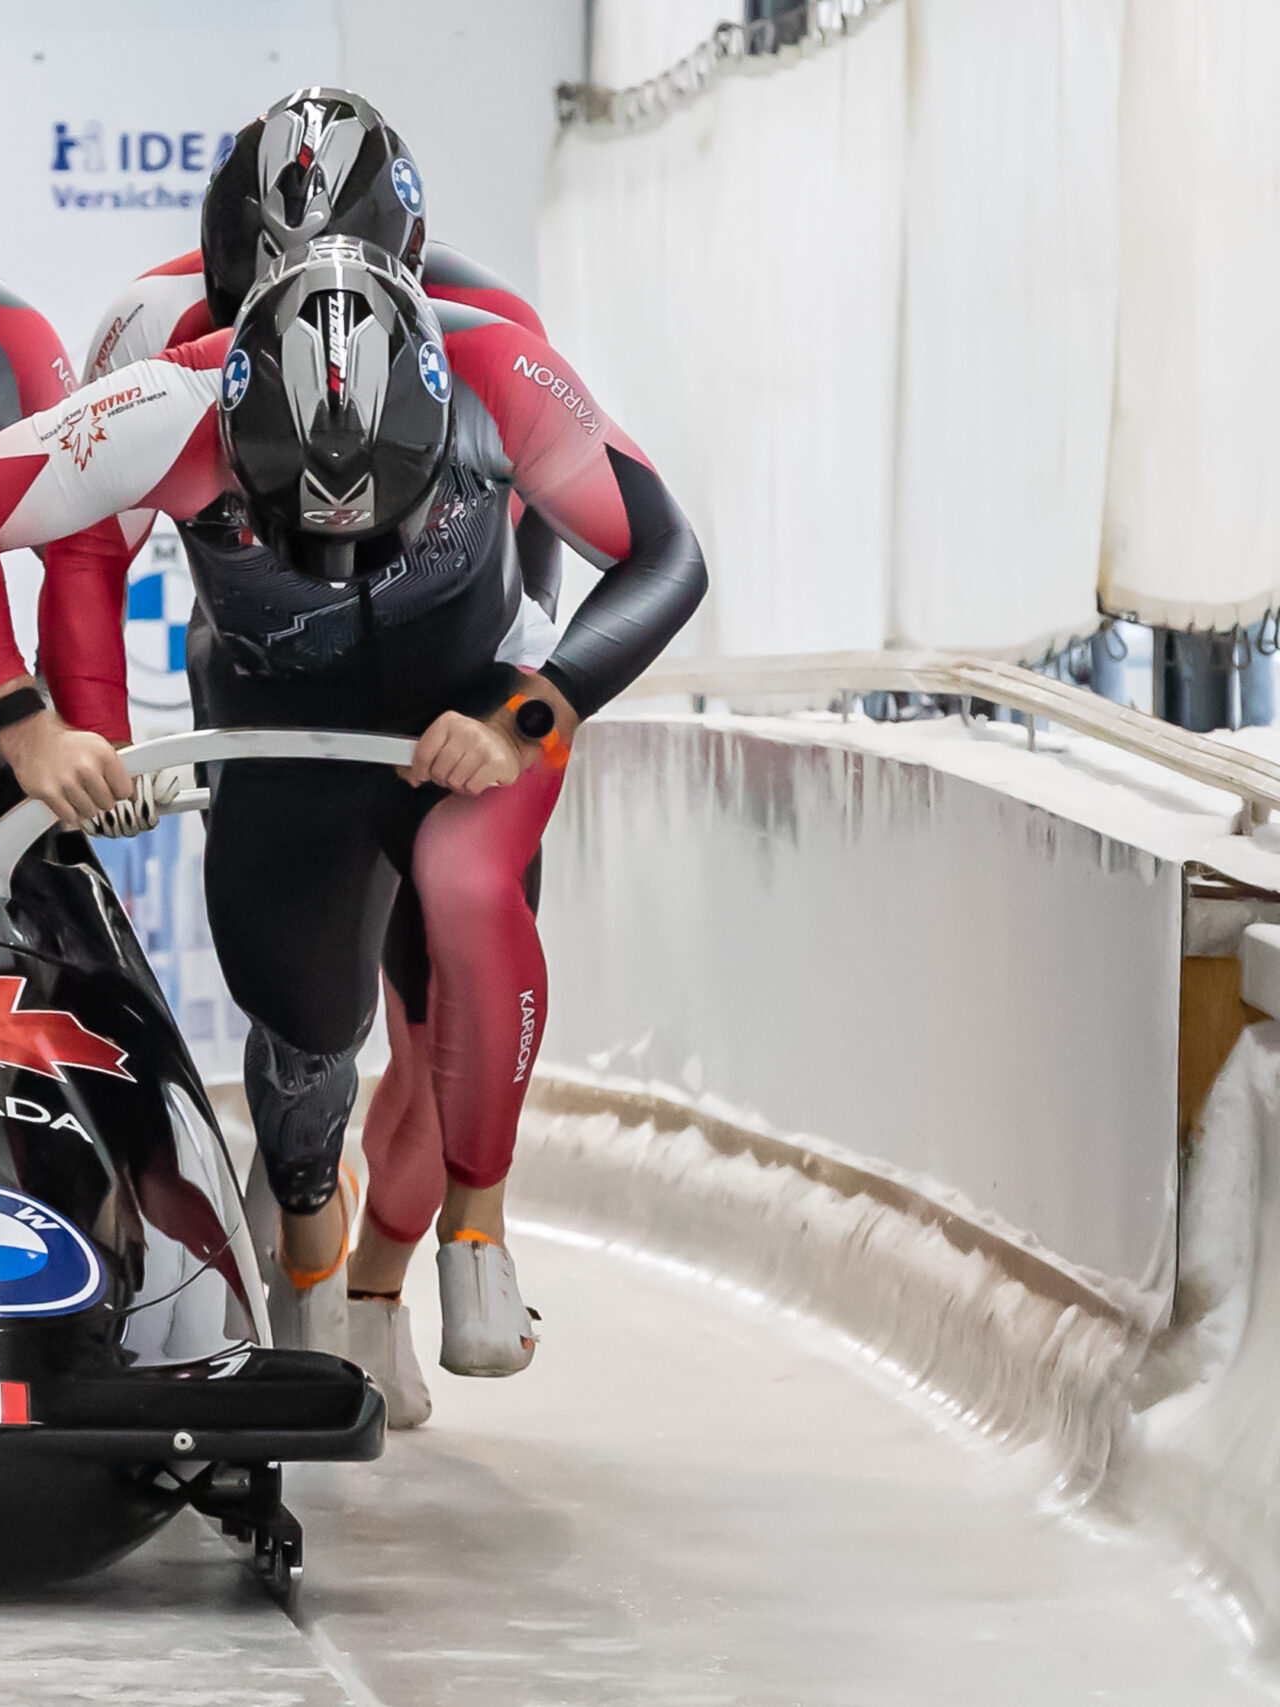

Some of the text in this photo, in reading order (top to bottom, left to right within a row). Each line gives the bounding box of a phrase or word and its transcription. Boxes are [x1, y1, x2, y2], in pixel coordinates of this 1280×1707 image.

[91, 386, 142, 416] CANADA
[512, 355, 600, 435] KARBON
[513, 989, 535, 1083] KARBON
